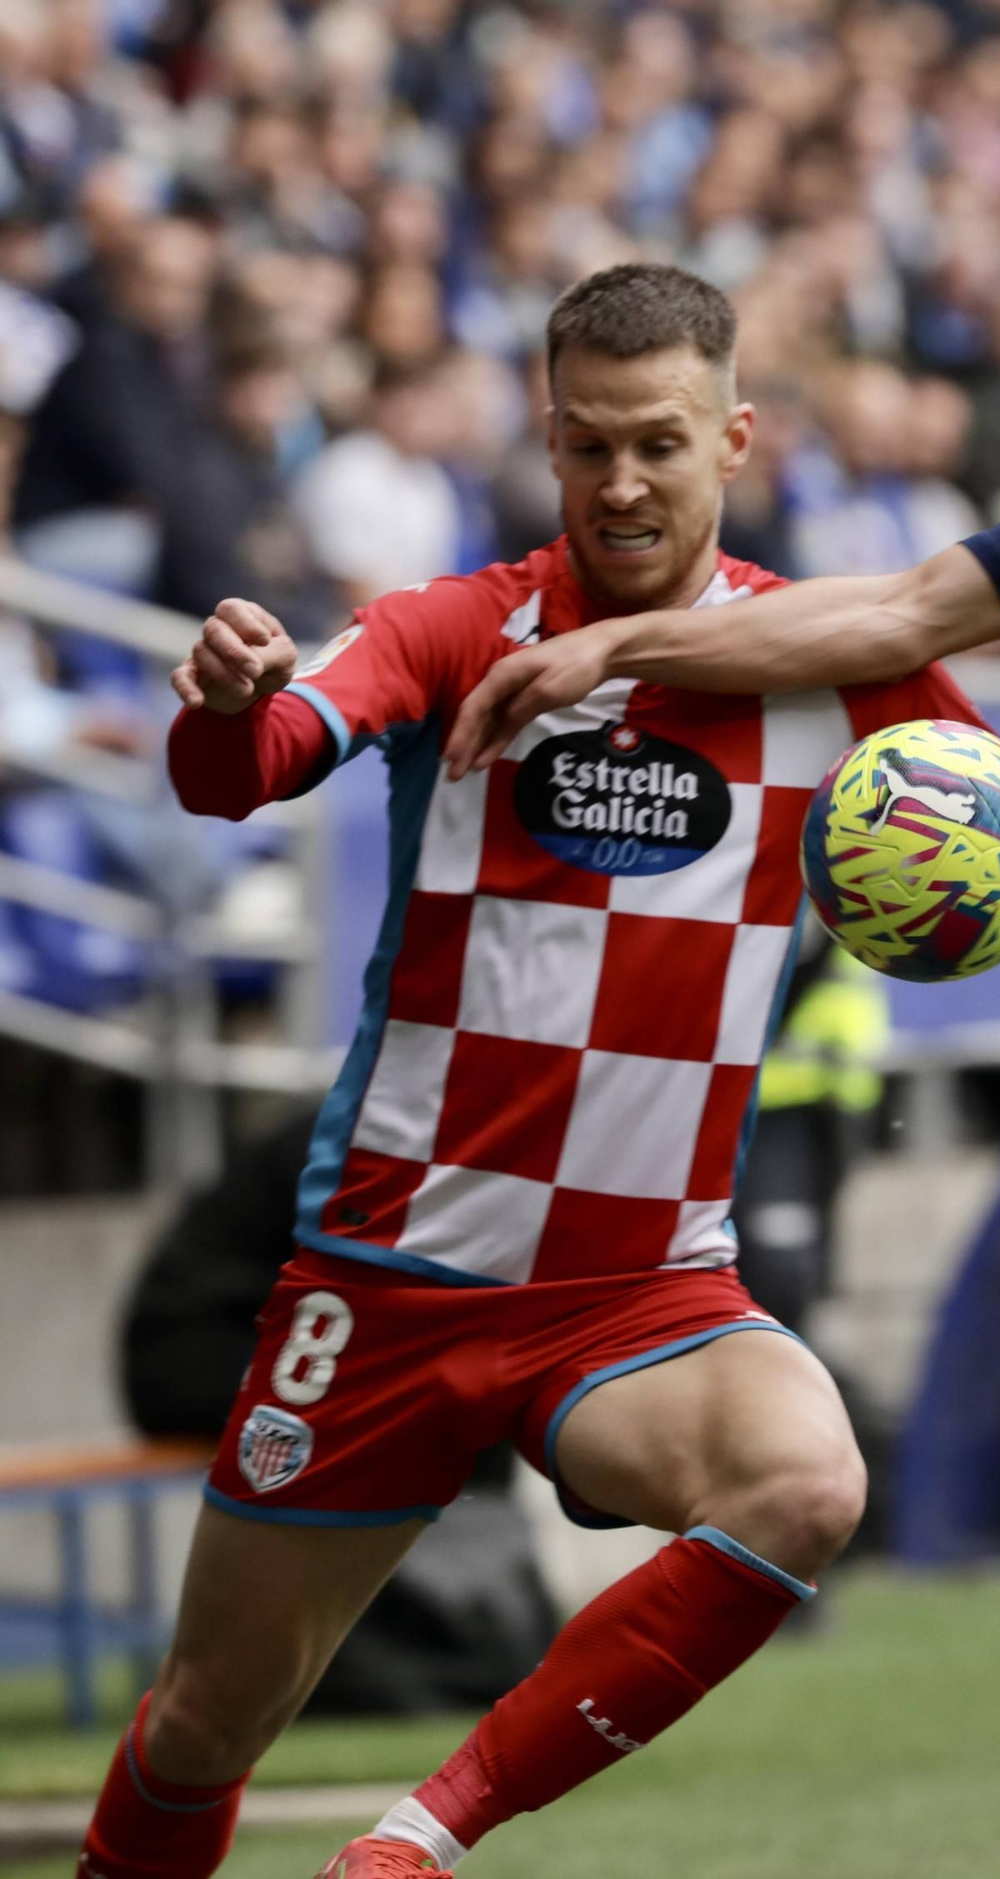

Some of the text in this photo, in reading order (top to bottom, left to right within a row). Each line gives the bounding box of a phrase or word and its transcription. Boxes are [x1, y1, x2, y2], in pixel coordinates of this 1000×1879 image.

[549, 751, 699, 800] Estrella
[551, 788, 689, 839] Galicia
[271, 1291, 356, 1405] 8
